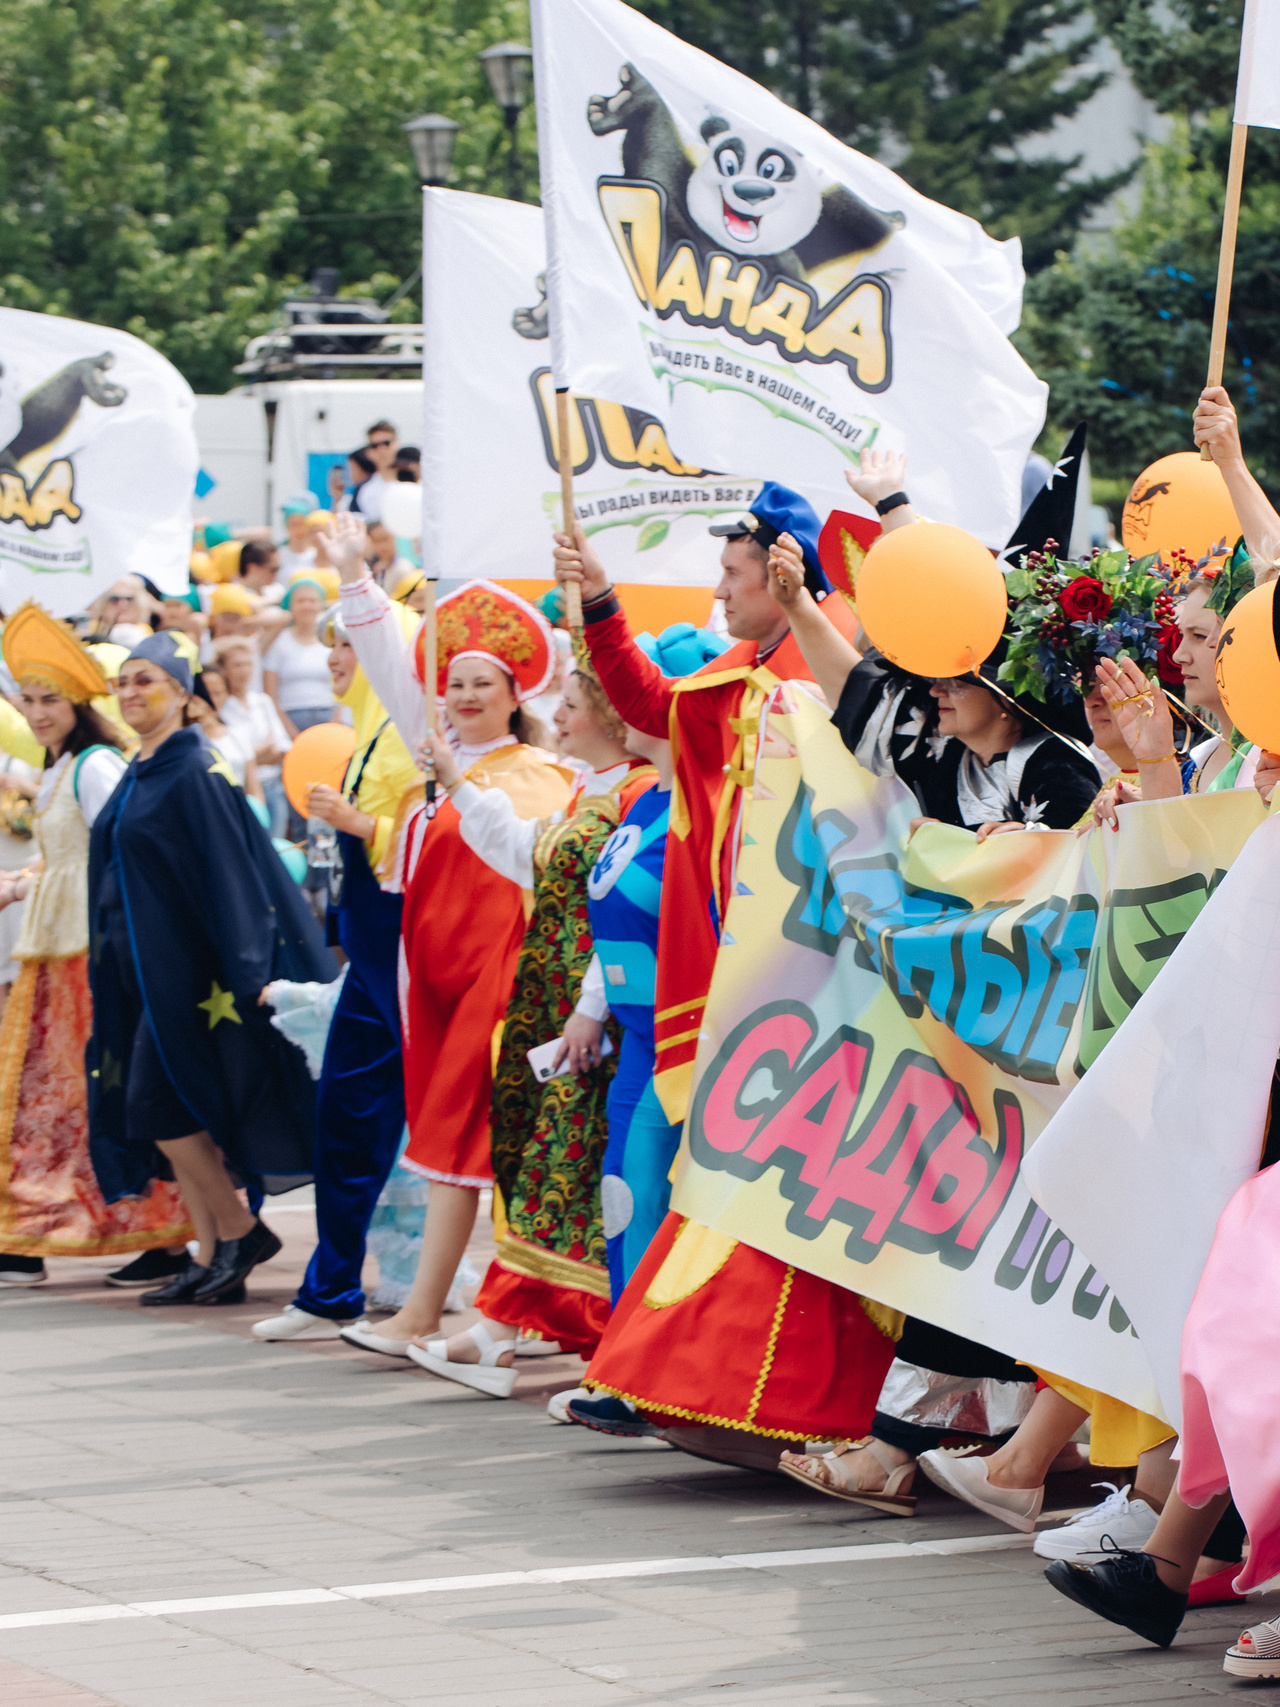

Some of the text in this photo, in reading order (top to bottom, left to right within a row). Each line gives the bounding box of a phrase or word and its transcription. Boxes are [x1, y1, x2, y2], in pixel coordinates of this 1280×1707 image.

[713, 356, 743, 379] Вас
[745, 370, 755, 383] в
[758, 373, 816, 413] нашем
[816, 405, 862, 443] саду!
[599, 493, 646, 516] рады
[650, 489, 710, 505] видеть
[714, 487, 743, 502] Вас
[690, 999, 1025, 1272] САДЫ
